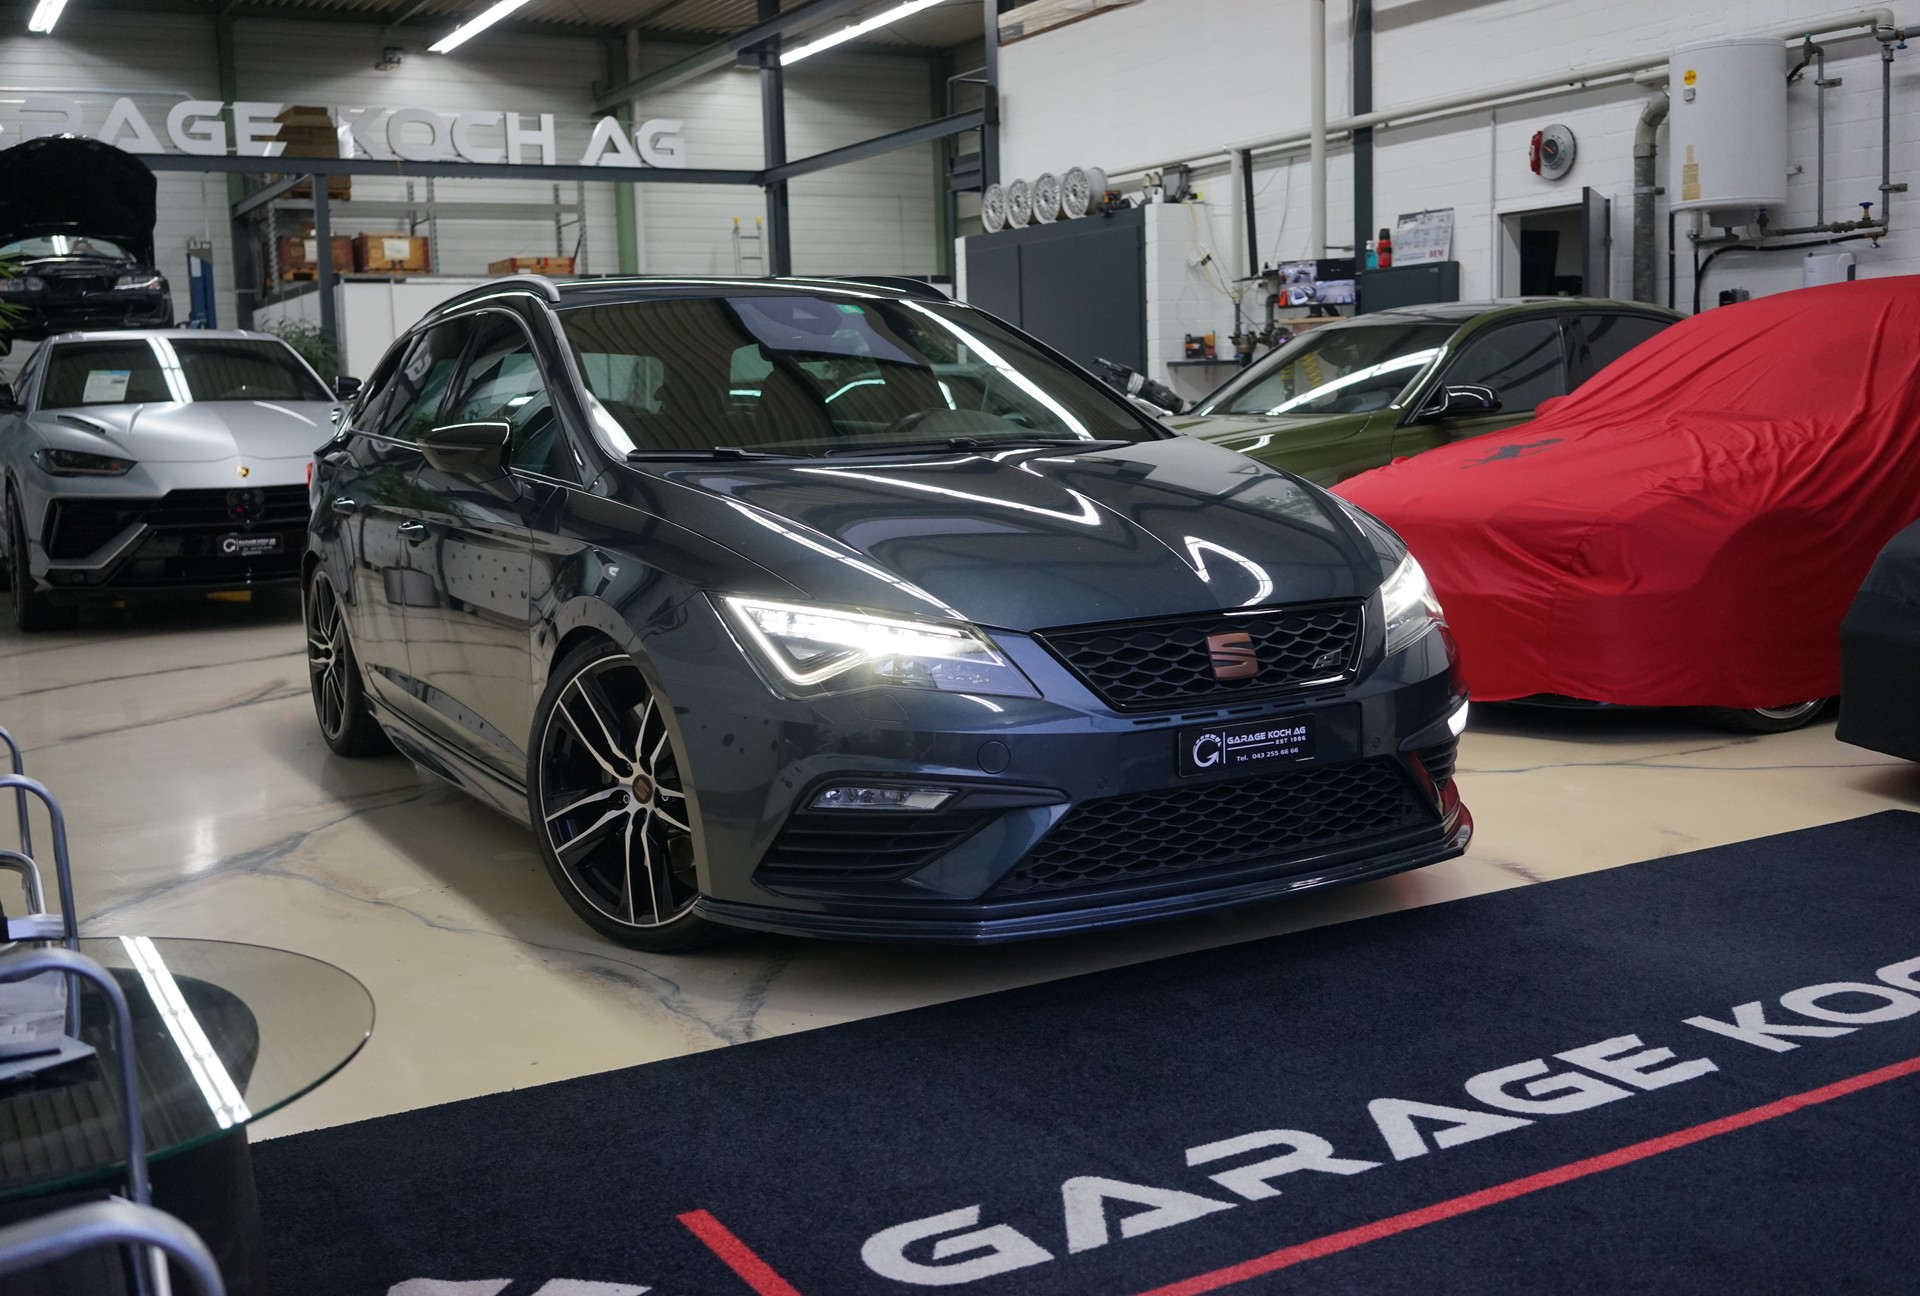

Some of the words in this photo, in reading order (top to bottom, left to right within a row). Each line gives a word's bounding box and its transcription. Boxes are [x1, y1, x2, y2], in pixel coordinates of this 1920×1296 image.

[0, 97, 288, 157] RAGE
[338, 106, 556, 164] KOCH
[580, 115, 685, 168] AG
[1227, 732, 1266, 745] GARAGE
[1268, 728, 1292, 739] KOCH
[1293, 726, 1306, 736] AG
[1290, 735, 1306, 743] 1986
[1252, 752, 1265, 760] 043
[1266, 750, 1279, 758] 255
[1280, 748, 1289, 756] 66
[861, 1033, 1718, 1286] GARAGE
